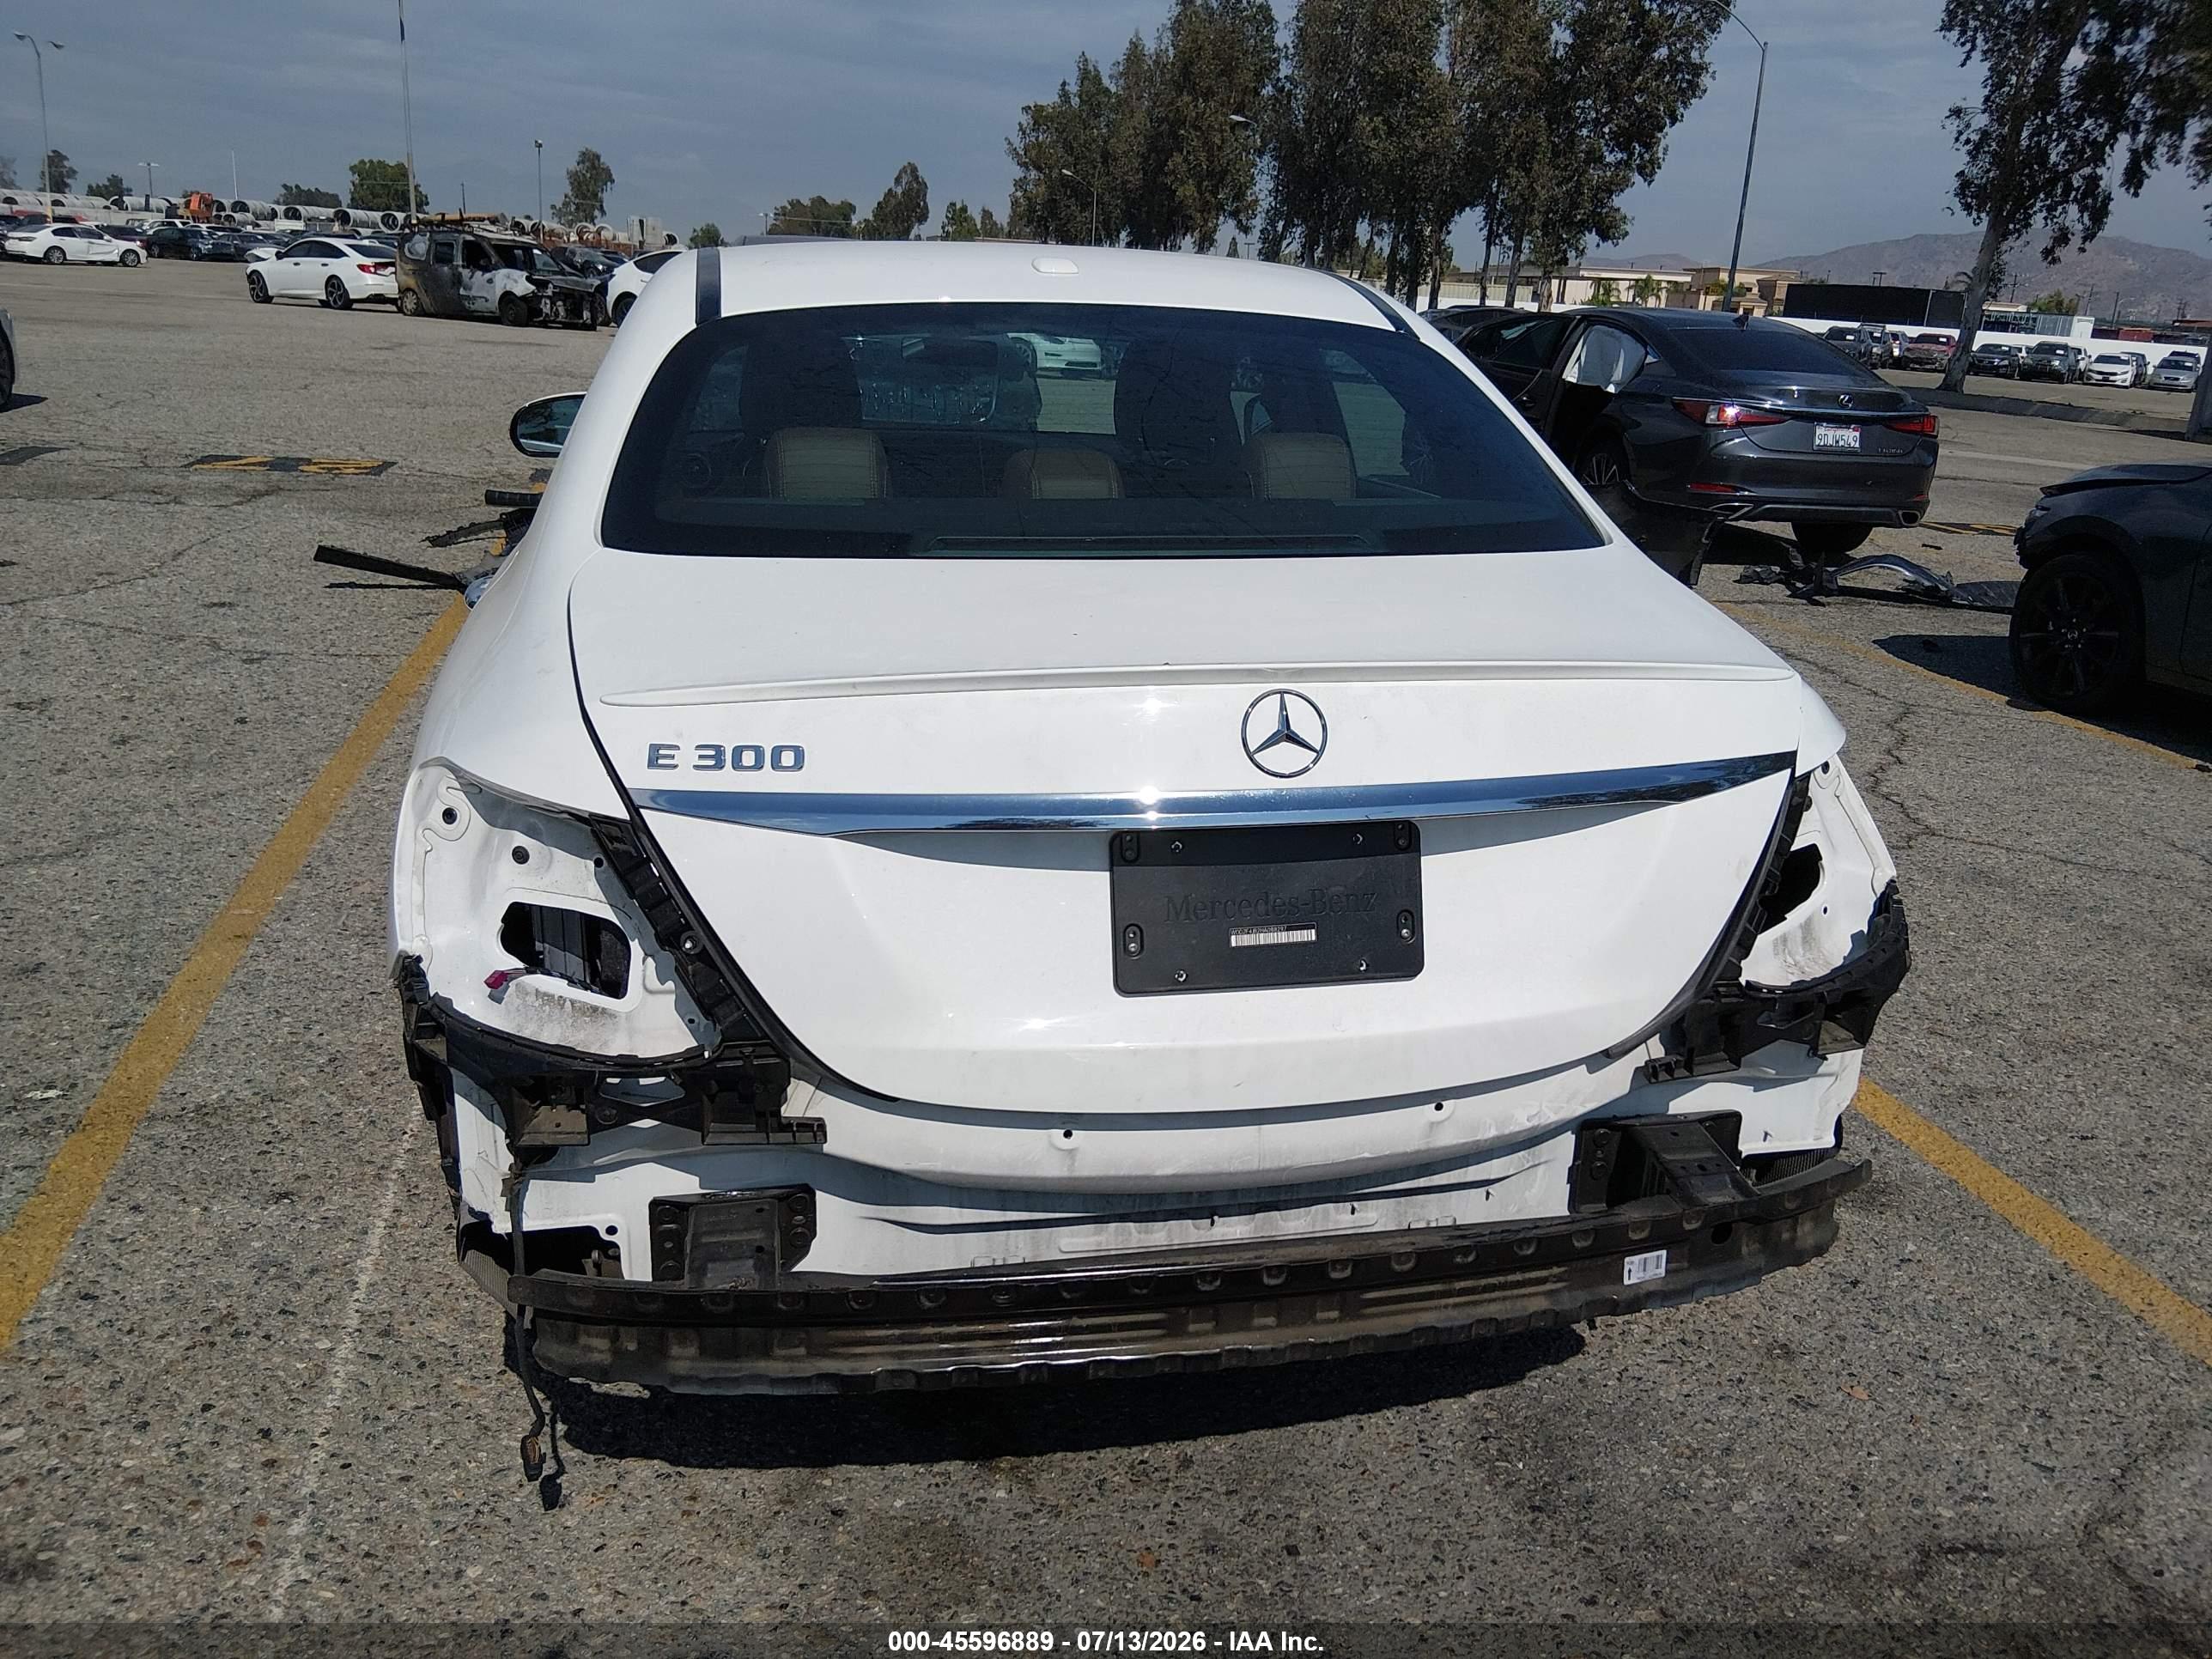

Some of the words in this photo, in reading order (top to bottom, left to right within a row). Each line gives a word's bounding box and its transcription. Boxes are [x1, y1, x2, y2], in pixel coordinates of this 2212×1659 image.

[1817, 433, 1858, 447] 9DJW549
[647, 743, 680, 770] E
[692, 744, 805, 772] 300
[1164, 888, 1378, 922] Mercedes-Benz
